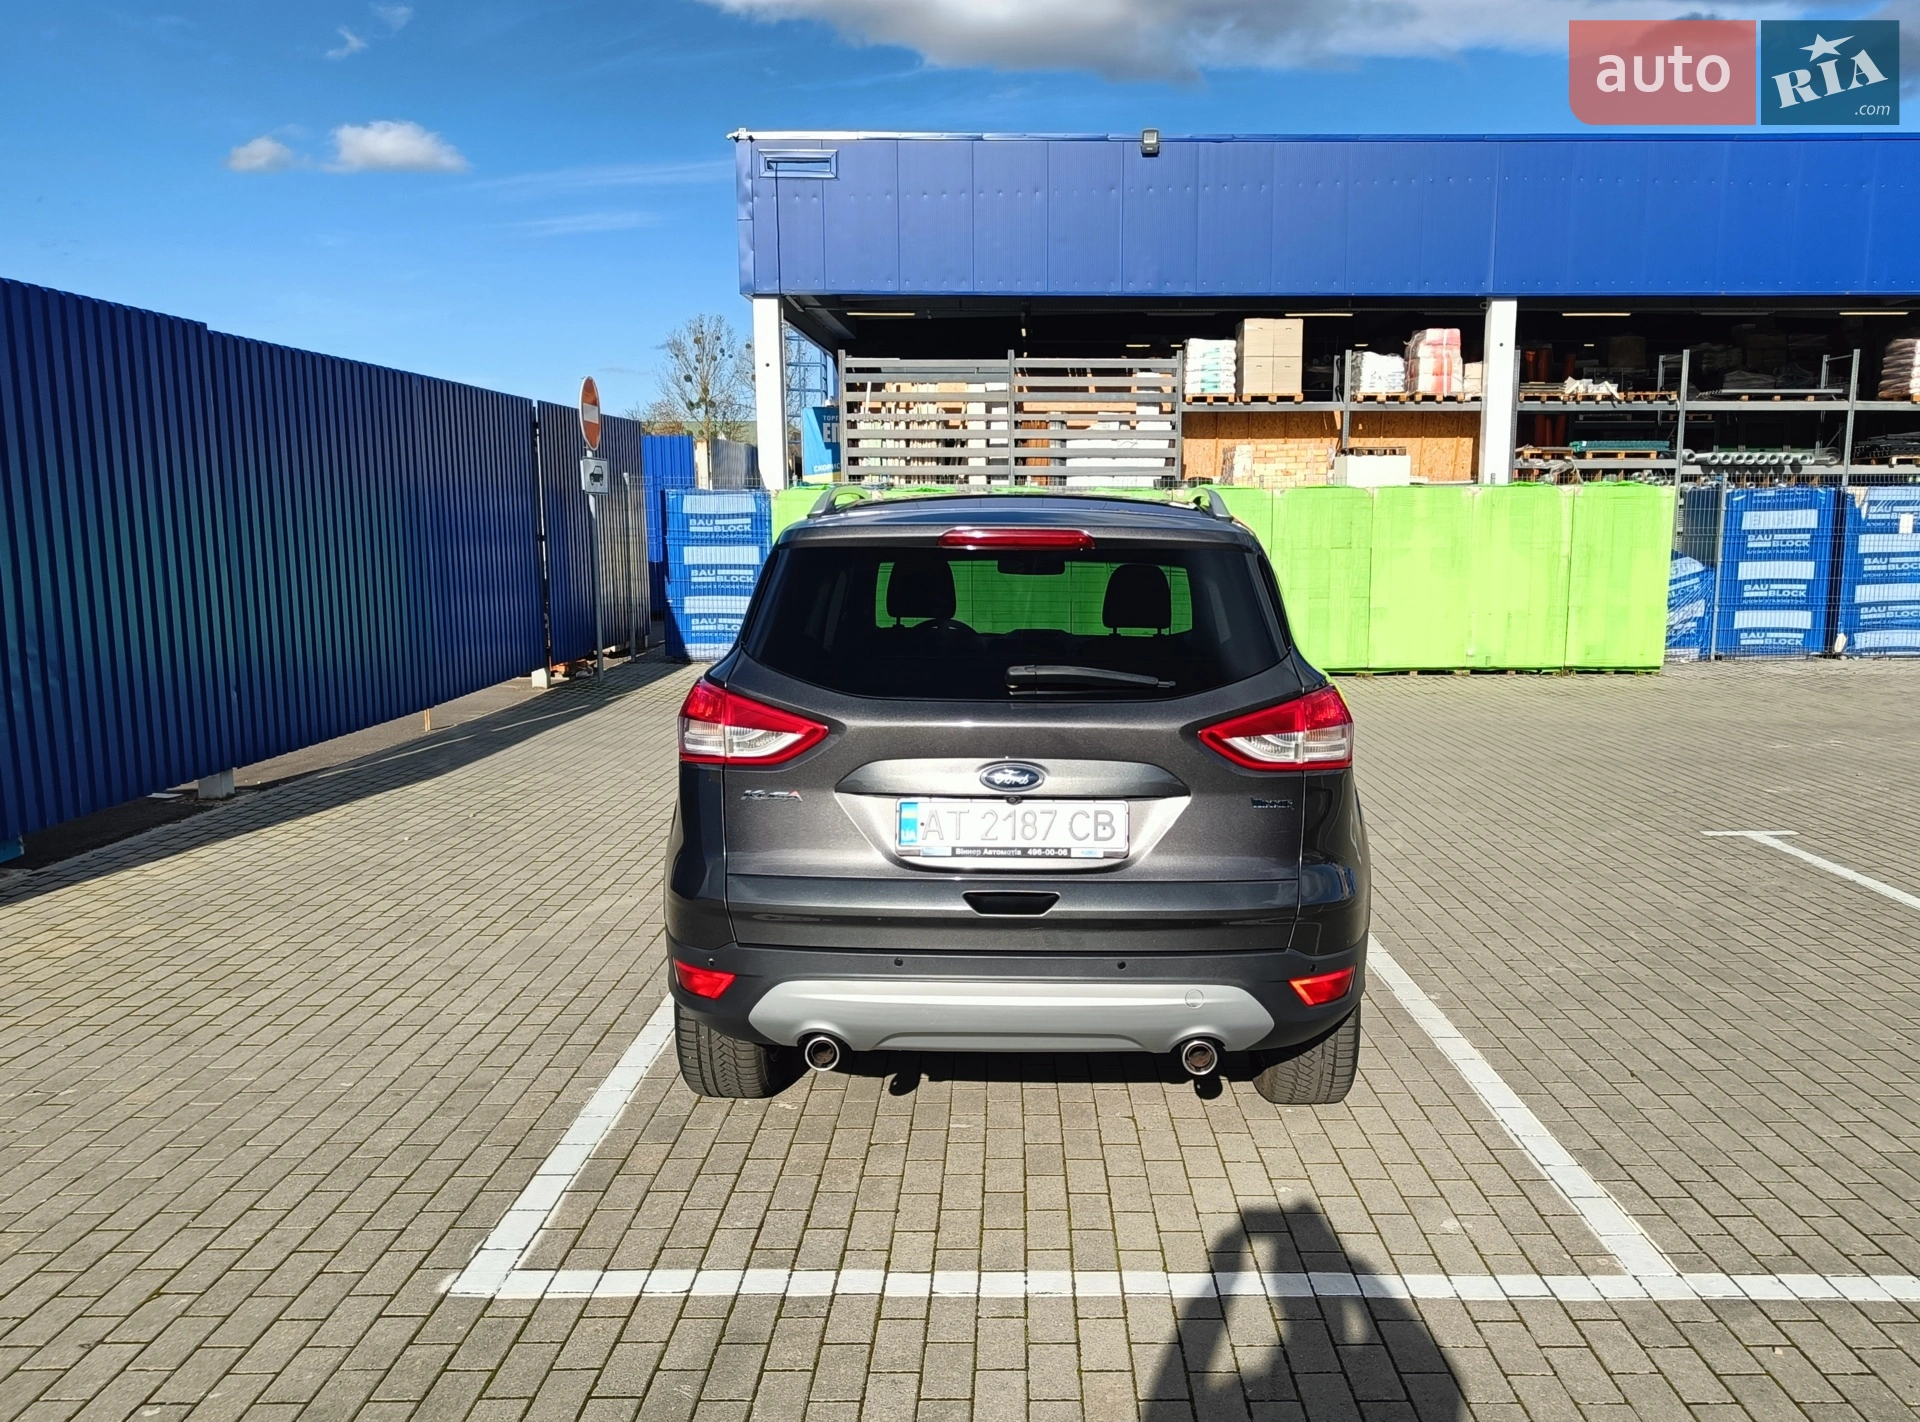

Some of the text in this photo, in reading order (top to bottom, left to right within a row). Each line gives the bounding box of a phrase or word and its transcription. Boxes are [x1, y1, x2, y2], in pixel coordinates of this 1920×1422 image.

[690, 518, 713, 526] BAU
[713, 524, 752, 533] BLOCK
[1747, 534, 1773, 542] BAU
[1863, 557, 1888, 565] BAU
[1887, 562, 1920, 570] BLOC
[691, 569, 716, 577] BAU
[716, 575, 754, 583] BLOCK
[1743, 583, 1769, 591] BAU
[1860, 606, 1886, 614] BAU
[1886, 610, 1920, 618] BLOC
[691, 617, 716, 625] BAU
[1764, 638, 1803, 646] BLOCK
[994, 769, 1030, 785] Ford
[922, 809, 1116, 842] AT 2187 CB
[1027, 848, 1068, 856] 496-00-06
